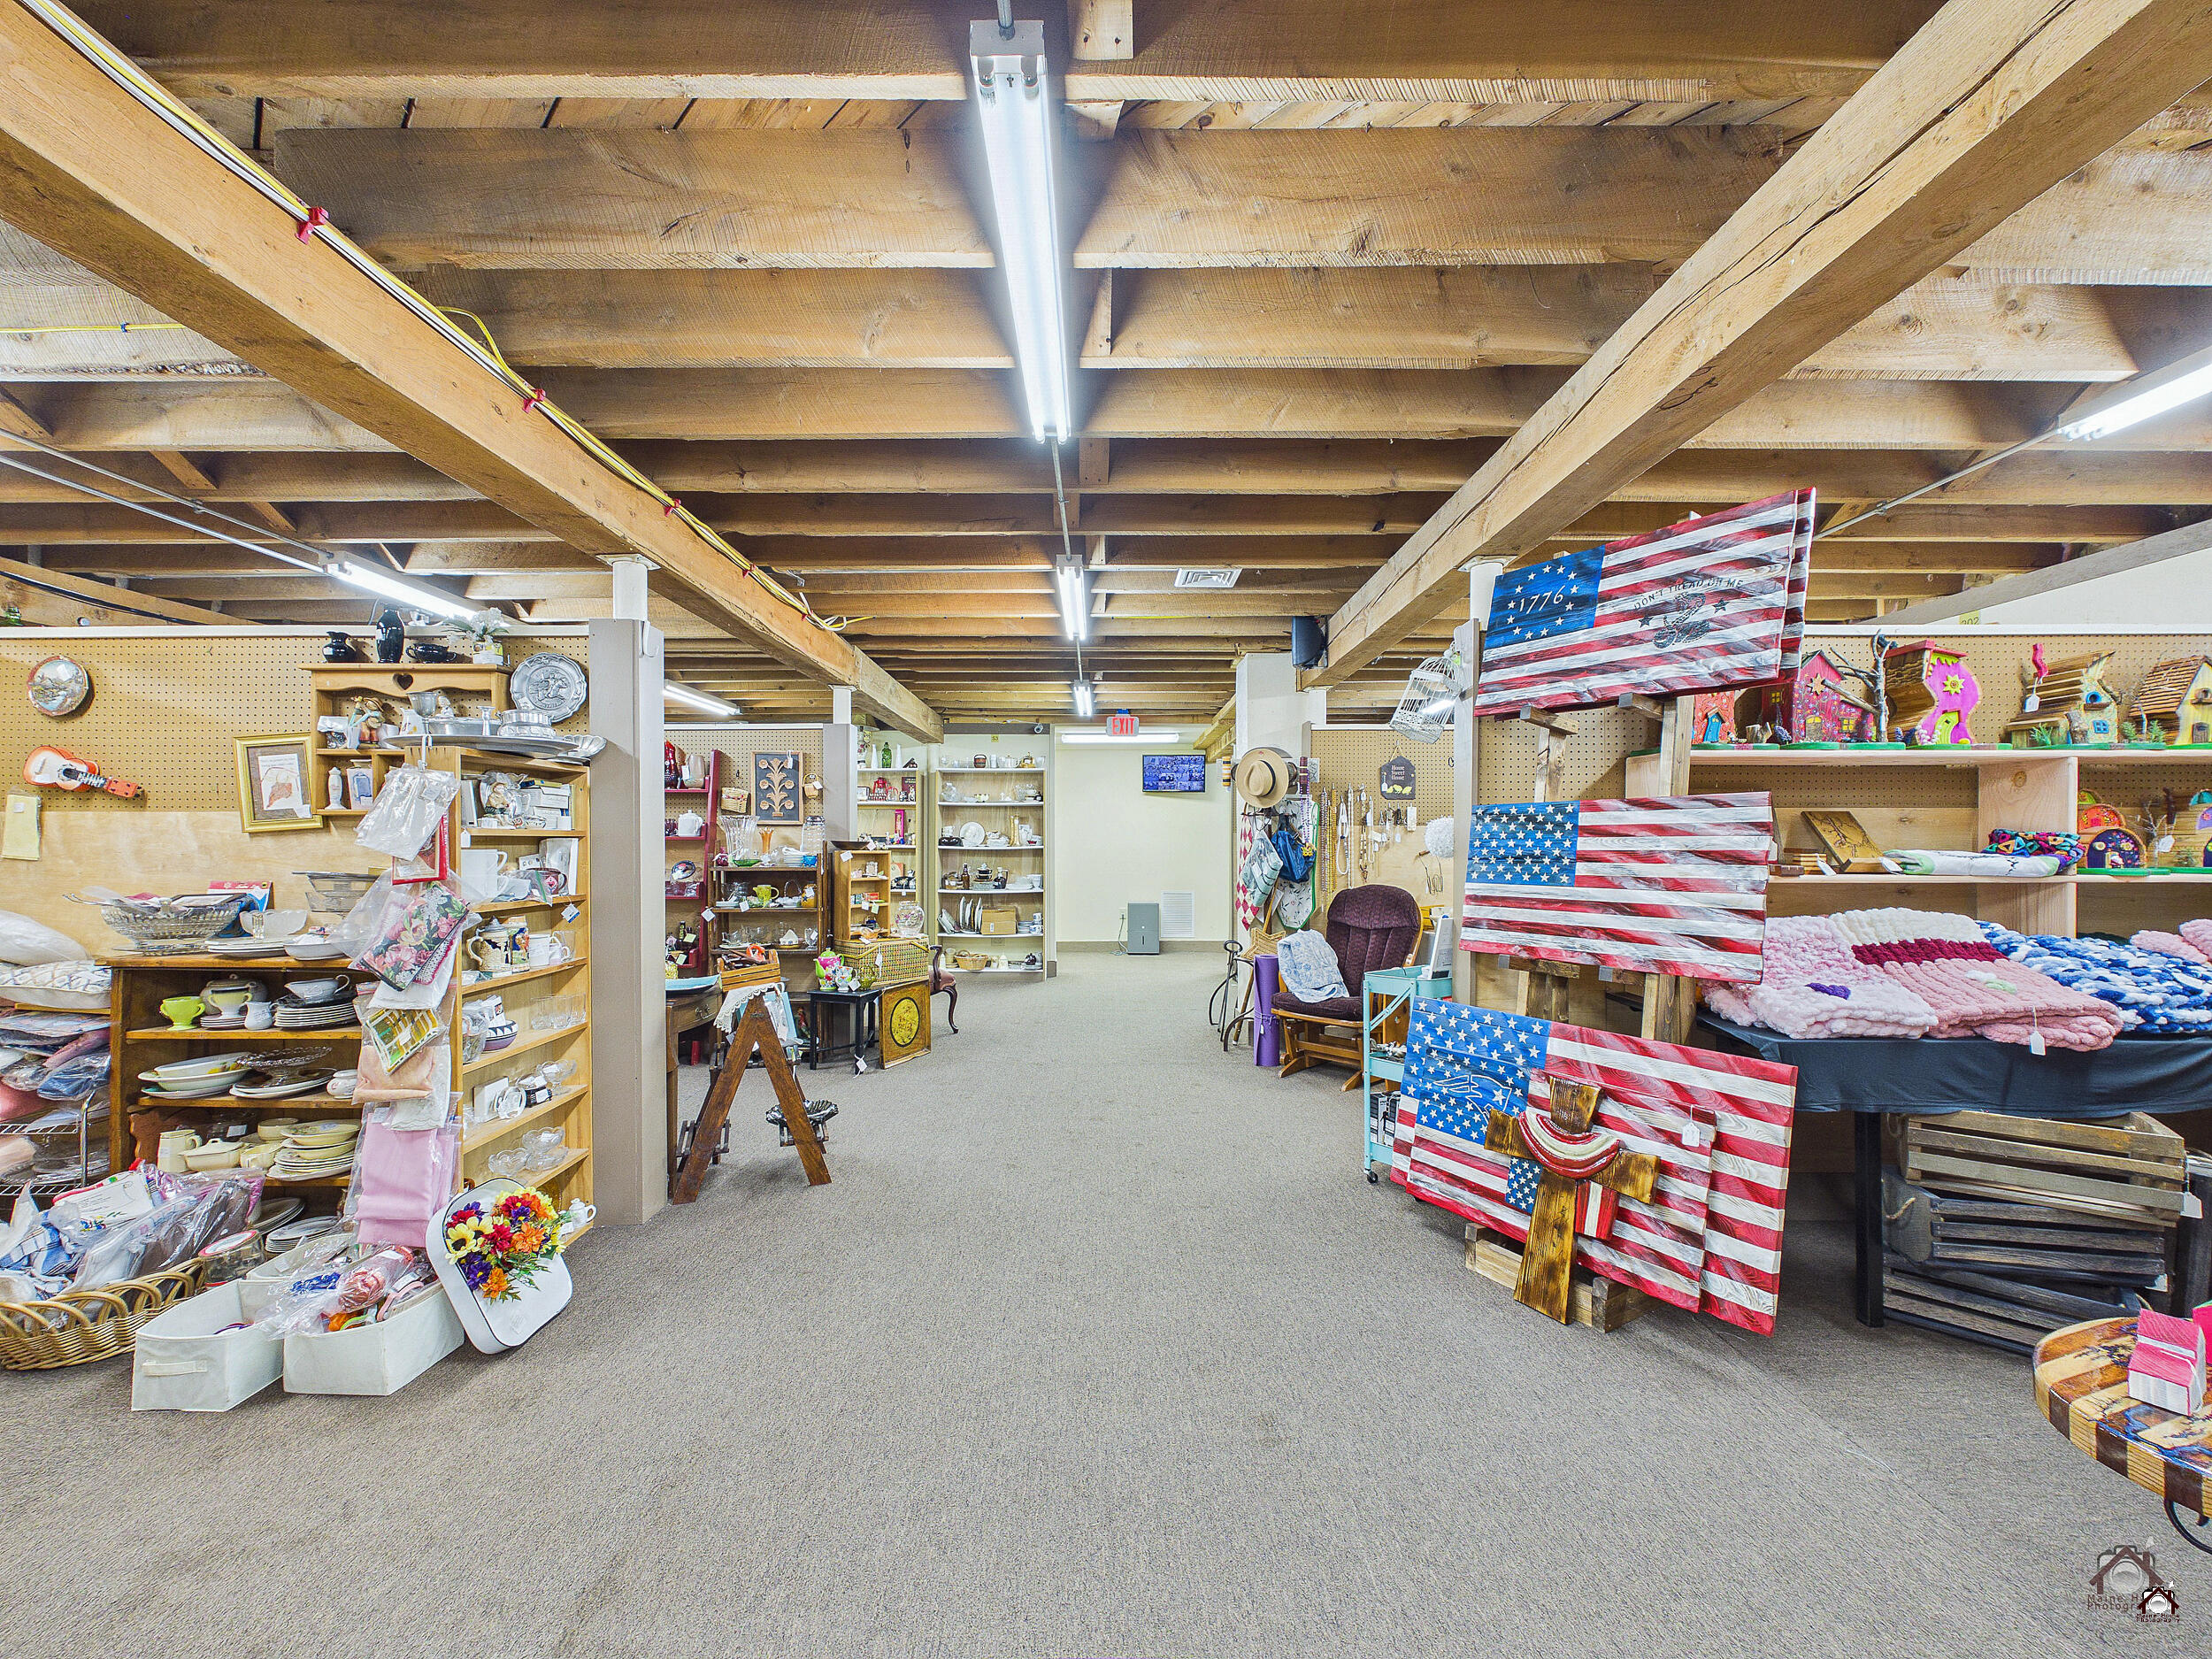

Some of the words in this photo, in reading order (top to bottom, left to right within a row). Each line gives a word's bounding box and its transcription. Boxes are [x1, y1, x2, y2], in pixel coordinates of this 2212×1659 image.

[1519, 584, 1566, 615] 1776
[1633, 588, 1663, 610] DON'T
[1668, 580, 1703, 593] TREAD
[1725, 578, 1744, 589] ME
[1111, 717, 1135, 735] EXIT
